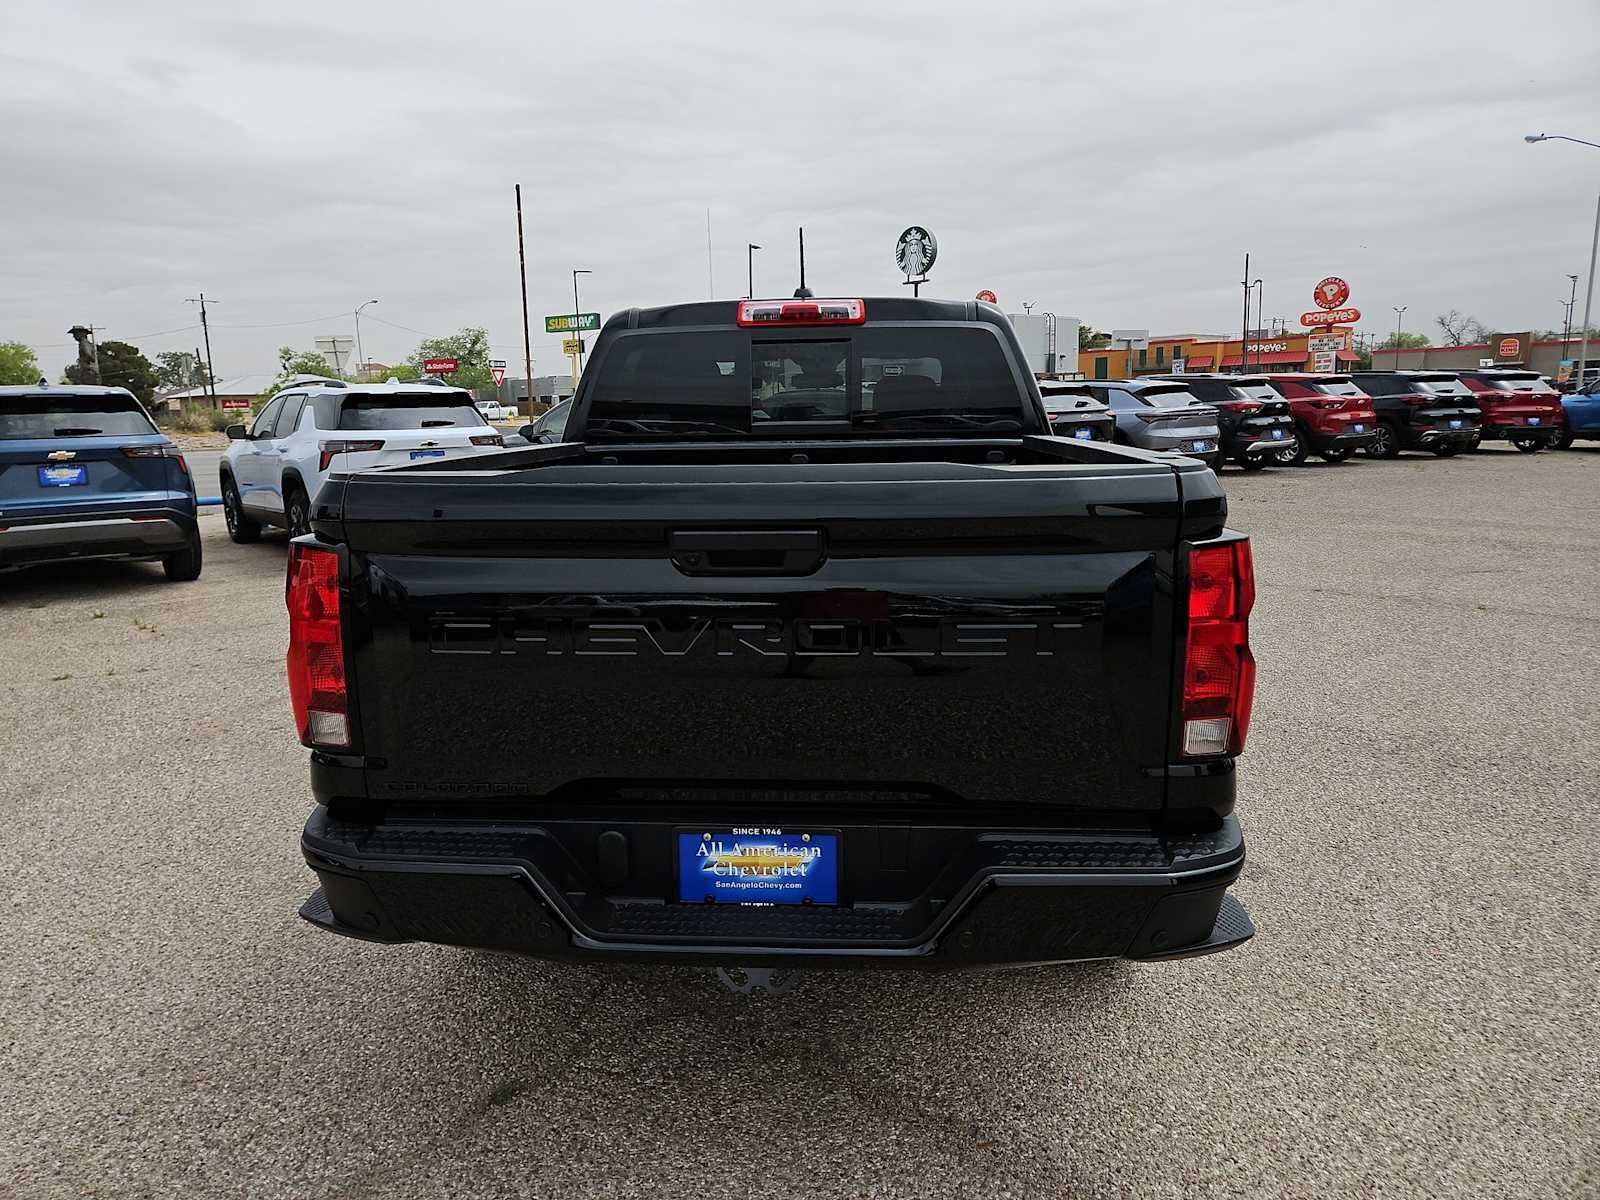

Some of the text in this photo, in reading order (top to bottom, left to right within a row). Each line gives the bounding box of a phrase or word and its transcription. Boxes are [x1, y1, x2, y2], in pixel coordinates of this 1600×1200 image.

[547, 315, 594, 330] SUBWAY
[430, 617, 1084, 657] CHEVROLET
[732, 827, 782, 836] SINCE 1946
[695, 841, 822, 858] All American
[713, 861, 808, 877] Chevrolet
[715, 881, 802, 891] SanAngeloChevy.com
